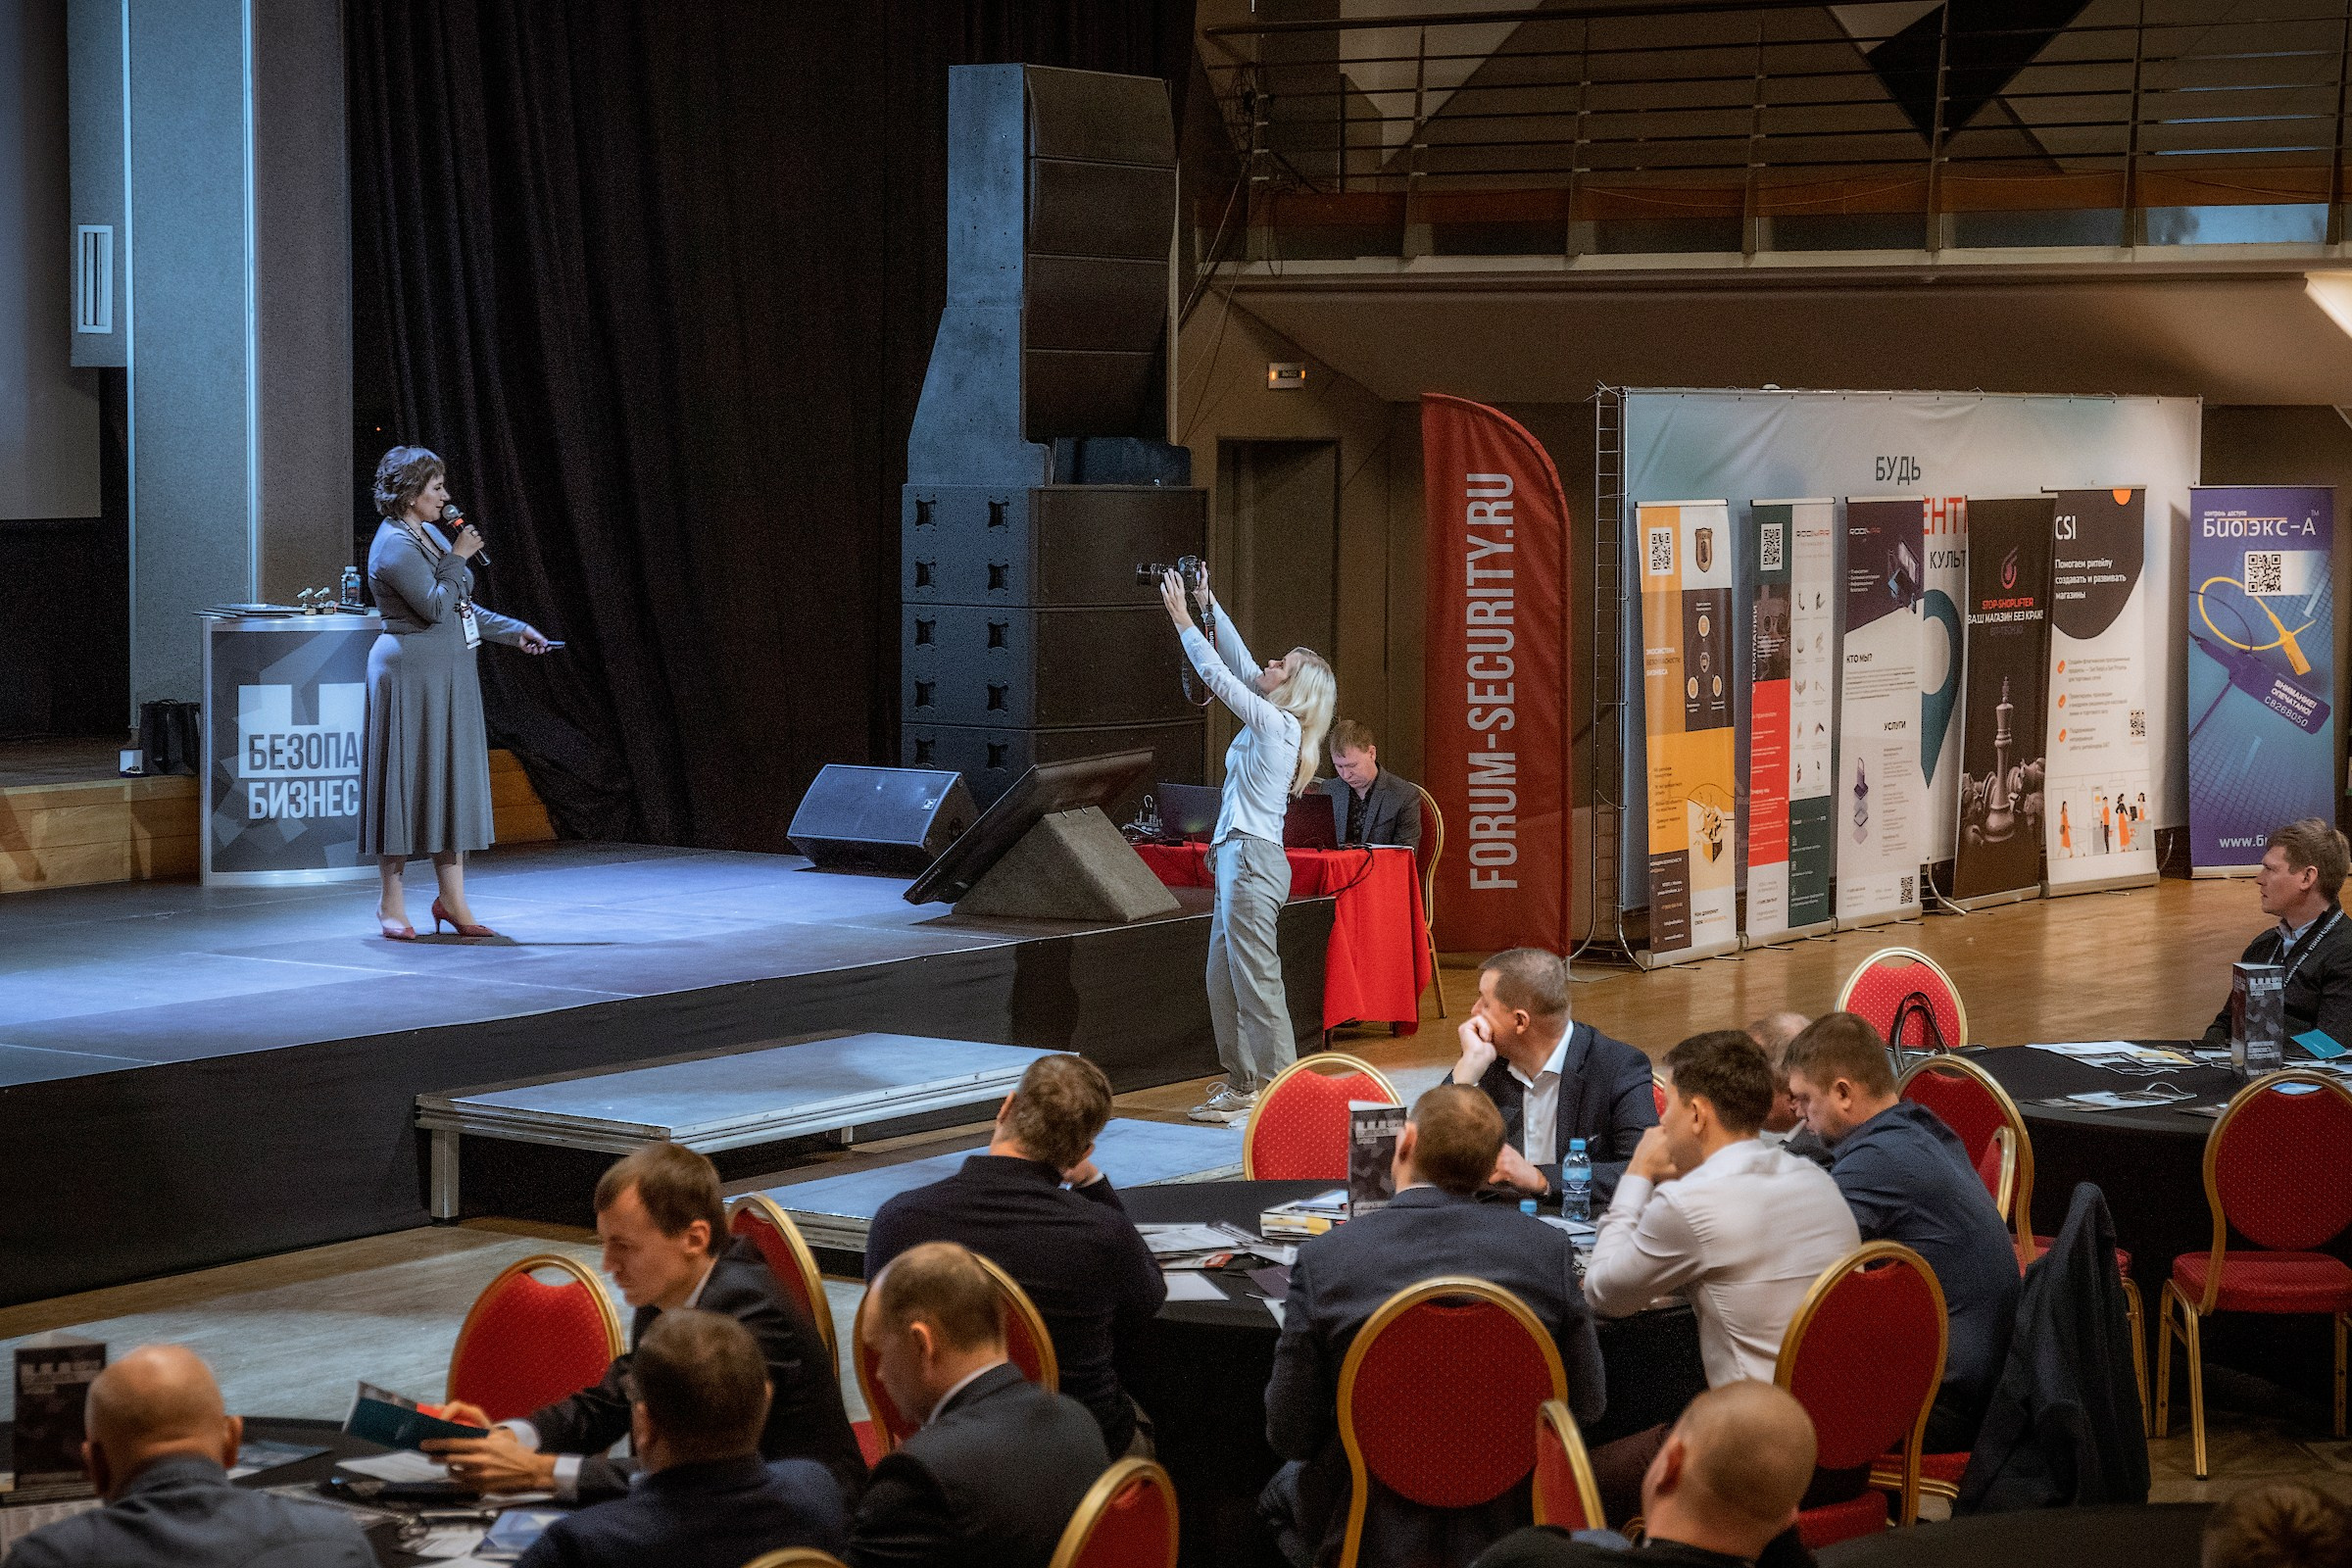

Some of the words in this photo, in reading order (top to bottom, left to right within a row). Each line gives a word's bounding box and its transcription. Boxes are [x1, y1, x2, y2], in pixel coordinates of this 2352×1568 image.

[1875, 456, 1921, 486] БУДЬ
[2055, 515, 2077, 540] CSI
[2055, 559, 2086, 568] Помогаем
[2086, 558, 2113, 569] ритейлу
[2093, 574, 2127, 584] развивать
[1968, 613, 1984, 624] ВАШ
[1984, 612, 2012, 623] МАГАЗИН
[2013, 611, 2025, 621] БЕЗ
[1859, 653, 1872, 662] МЫ?
[1466, 473, 1518, 889] FORUM-SECURITY.RU
[1884, 720, 1906, 730] УСЛУГИ
[248, 731, 364, 771] БЕЗОПА
[248, 778, 359, 820] БИЗНЕС
